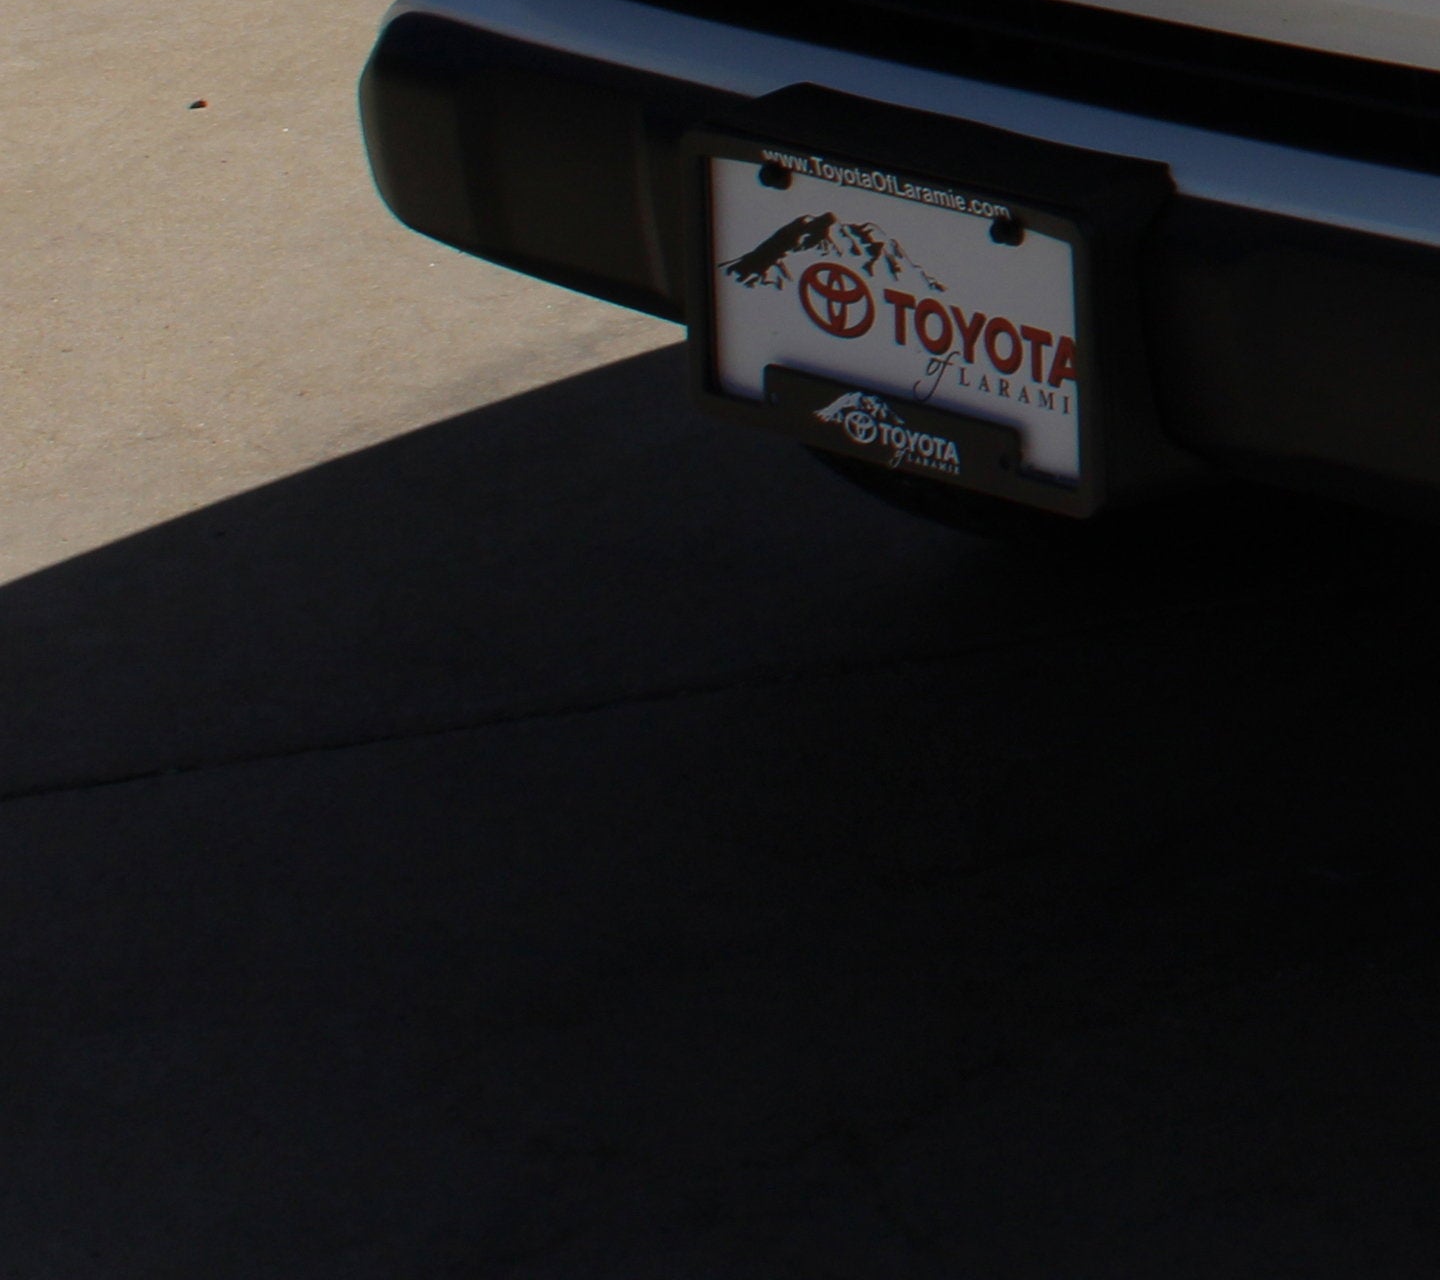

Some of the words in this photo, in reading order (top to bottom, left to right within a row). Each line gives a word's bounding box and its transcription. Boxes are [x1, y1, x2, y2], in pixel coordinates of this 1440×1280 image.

[762, 147, 1012, 220] www.ToyotaOfLaramie.com
[883, 288, 1078, 388] TOYOTA
[958, 369, 1072, 416] LARAMI
[879, 423, 960, 466] TOYOTA
